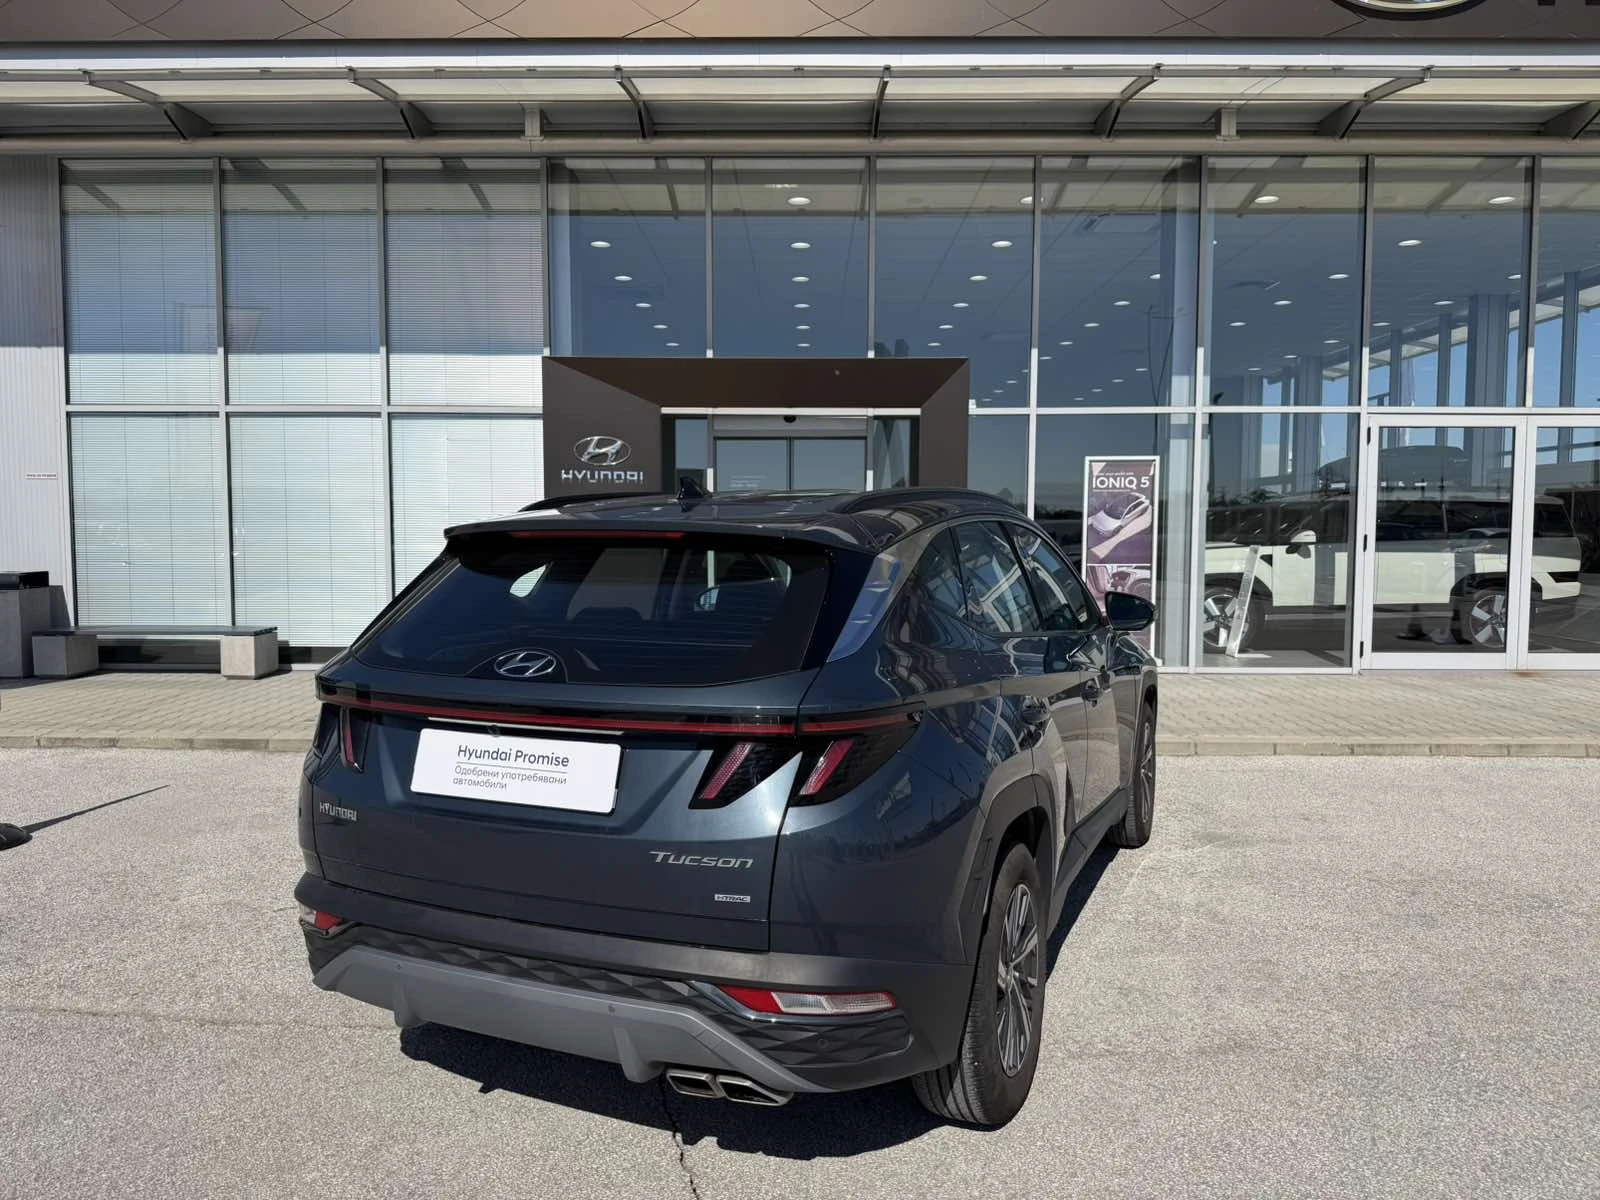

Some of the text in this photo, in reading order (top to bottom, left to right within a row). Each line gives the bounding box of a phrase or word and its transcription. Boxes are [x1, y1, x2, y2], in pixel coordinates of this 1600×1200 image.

[561, 469, 643, 483] HYUNDAI
[1092, 476, 1150, 490] IONIQ 5
[457, 744, 570, 767] Hyundai Promise
[452, 777, 507, 790] автомобили
[454, 765, 567, 785] Одобрени употребявани
[319, 801, 358, 821] HYUNDAI
